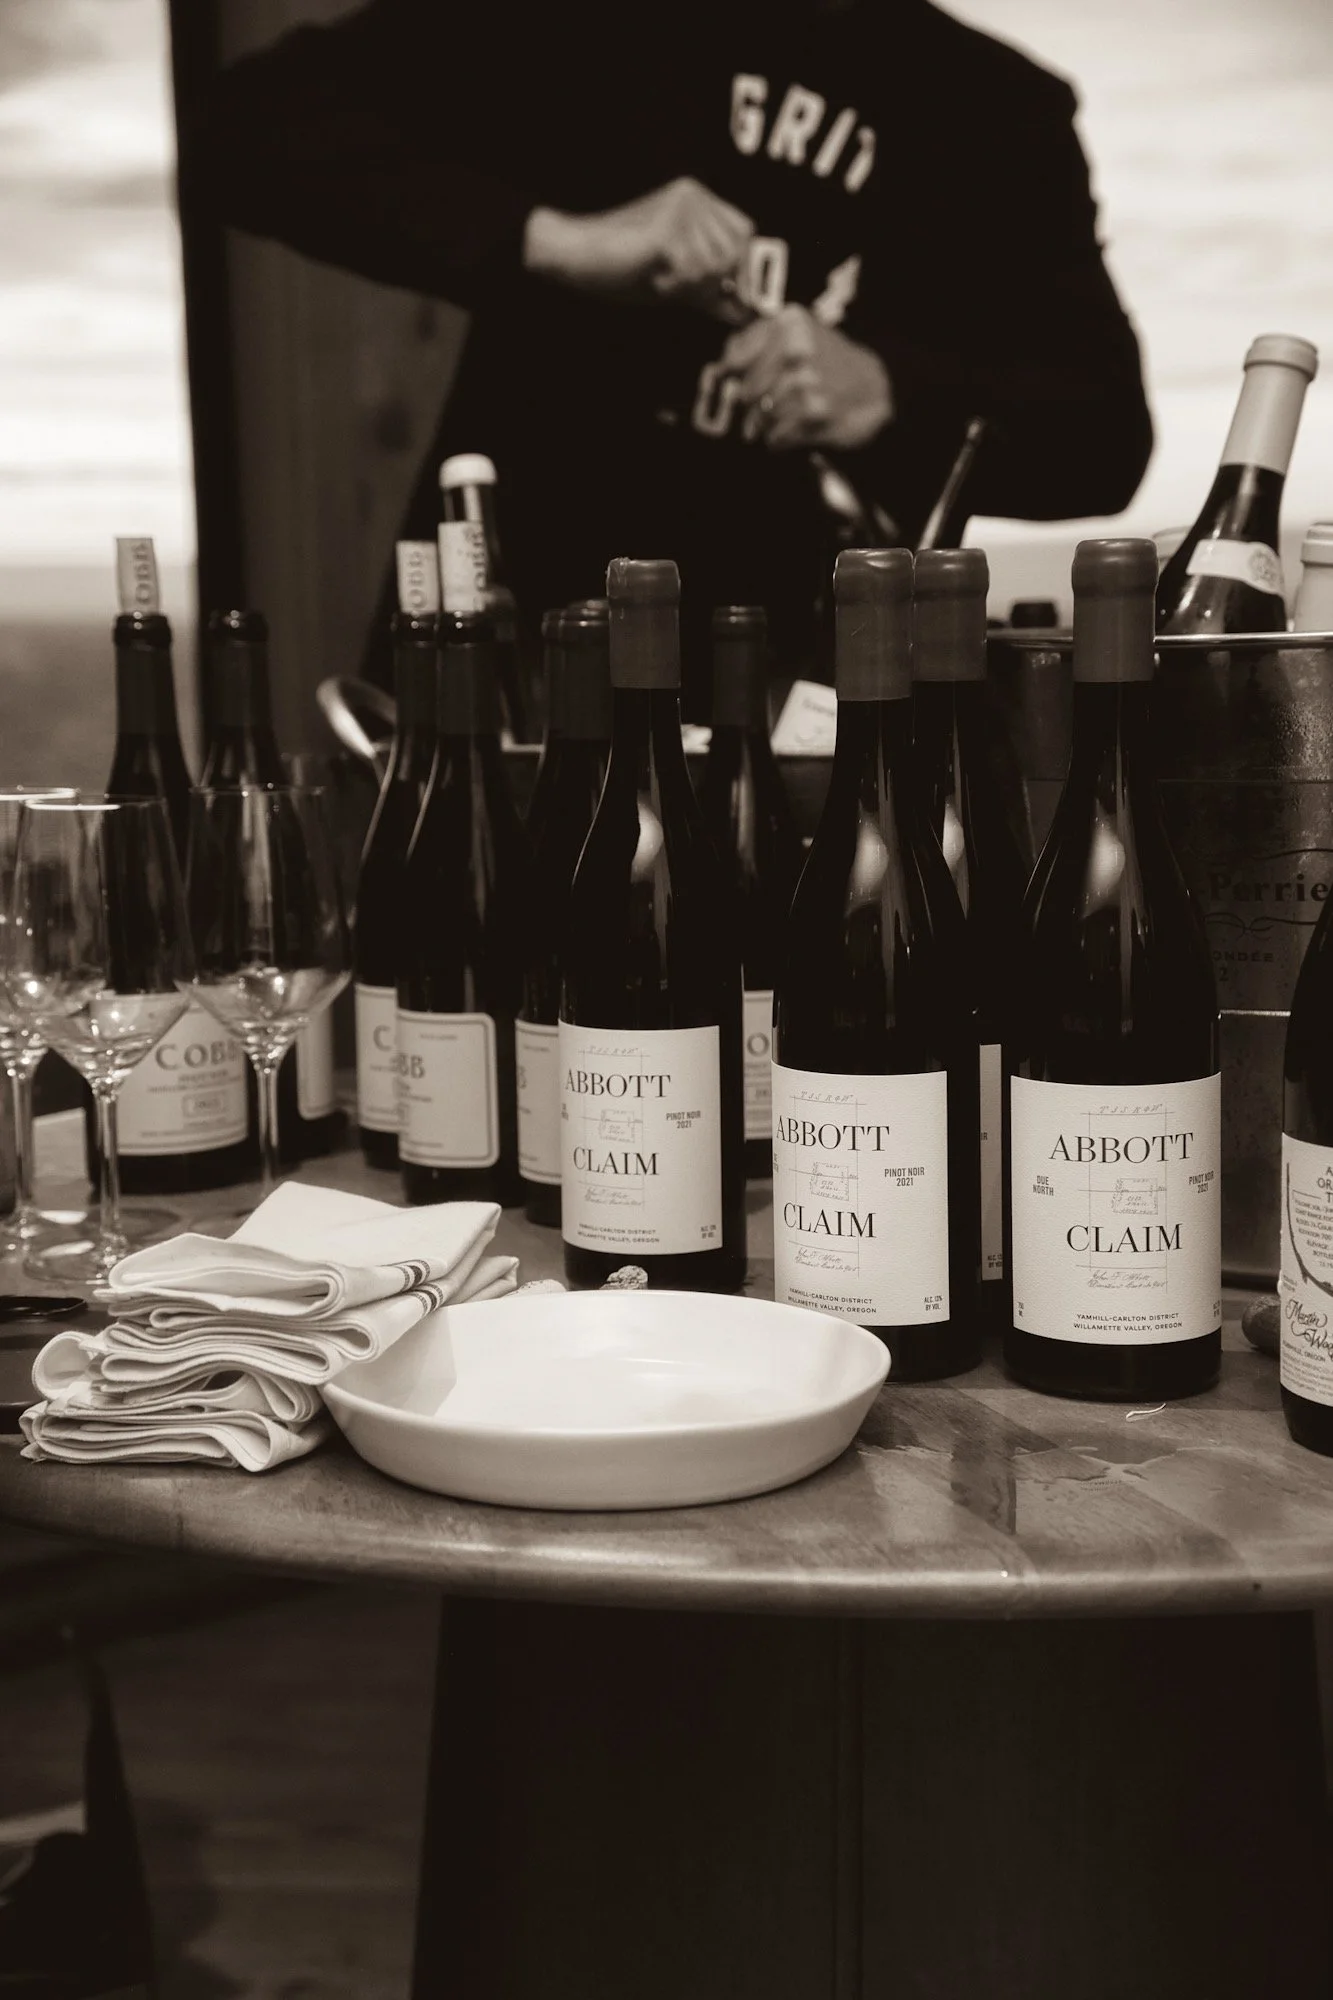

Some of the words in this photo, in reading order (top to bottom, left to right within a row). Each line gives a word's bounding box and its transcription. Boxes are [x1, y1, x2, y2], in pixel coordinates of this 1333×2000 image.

[565, 1069, 671, 1098] ABBOTT
[666, 1112, 685, 1121] PINOT
[677, 1120, 692, 1129] 2021
[776, 1115, 890, 1152] ABBOTT
[1048, 1132, 1194, 1164] ABBOTT
[573, 1146, 659, 1176] CLAIM
[884, 1168, 906, 1178] PINOT
[908, 1167, 925, 1177] NOIR
[896, 1177, 914, 1187] 2021
[1036, 1175, 1049, 1186] DUE
[1188, 1173, 1204, 1185] PINOT
[1033, 1184, 1054, 1196] NORTH
[1197, 1182, 1209, 1194] 2021
[783, 1202, 877, 1239] CLAIM
[1066, 1223, 1183, 1253] CLAIM
[820, 1303, 845, 1313] VALLEY,
[1077, 1313, 1146, 1322] YAMHILL-CARLTON
[1149, 1312, 1179, 1321] DISTRICT
[1073, 1322, 1121, 1331] WILLAMETTE
[1124, 1324, 1153, 1332] VALLEY,
[1154, 1321, 1183, 1330] OREGON
